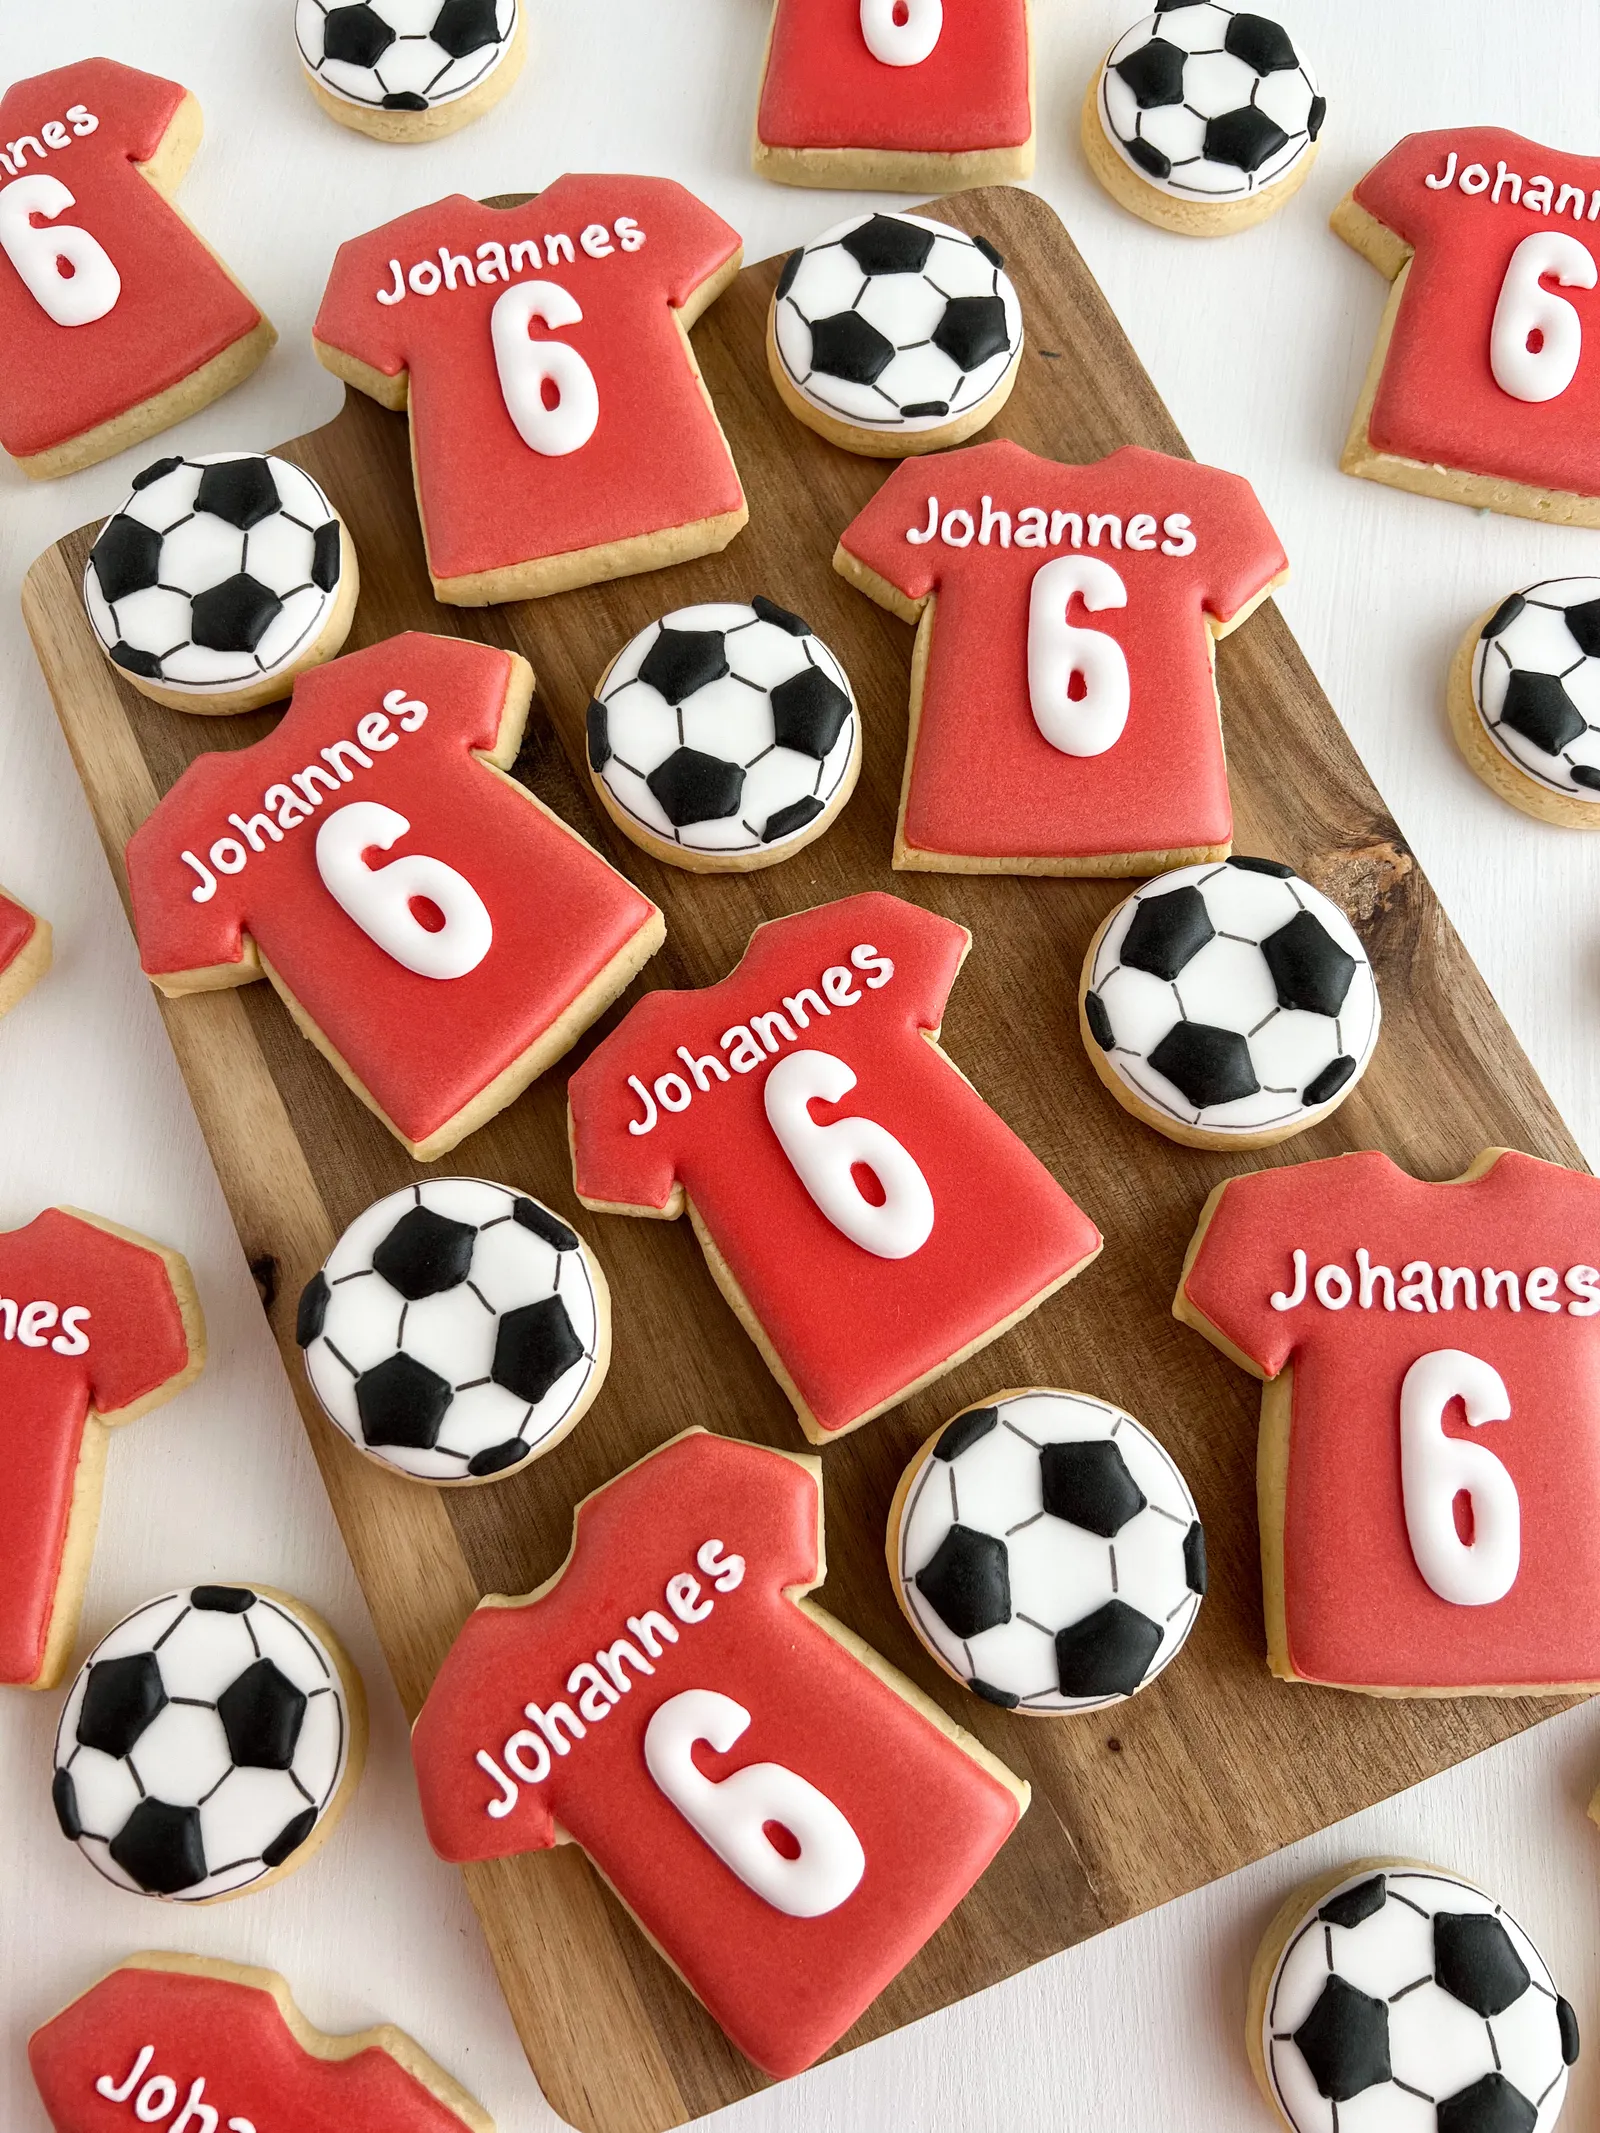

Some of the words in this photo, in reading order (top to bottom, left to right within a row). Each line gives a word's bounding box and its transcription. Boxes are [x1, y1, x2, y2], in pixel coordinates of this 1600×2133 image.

[0, 173, 121, 328] 6
[375, 215, 648, 307] Johannes
[1489, 230, 1599, 404] 6
[489, 279, 601, 458] 6
[905, 494, 1198, 560] Johannes
[1027, 553, 1132, 759] 6
[180, 688, 430, 904] Johannes
[314, 800, 494, 981] 6
[626, 942, 896, 1137] Johannes
[763, 1049, 936, 1260] 6
[1269, 1247, 1600, 1318] Johannes
[1399, 1348, 1522, 1607] 6
[475, 1537, 748, 1820] Johannes
[643, 1687, 867, 1919] 6
